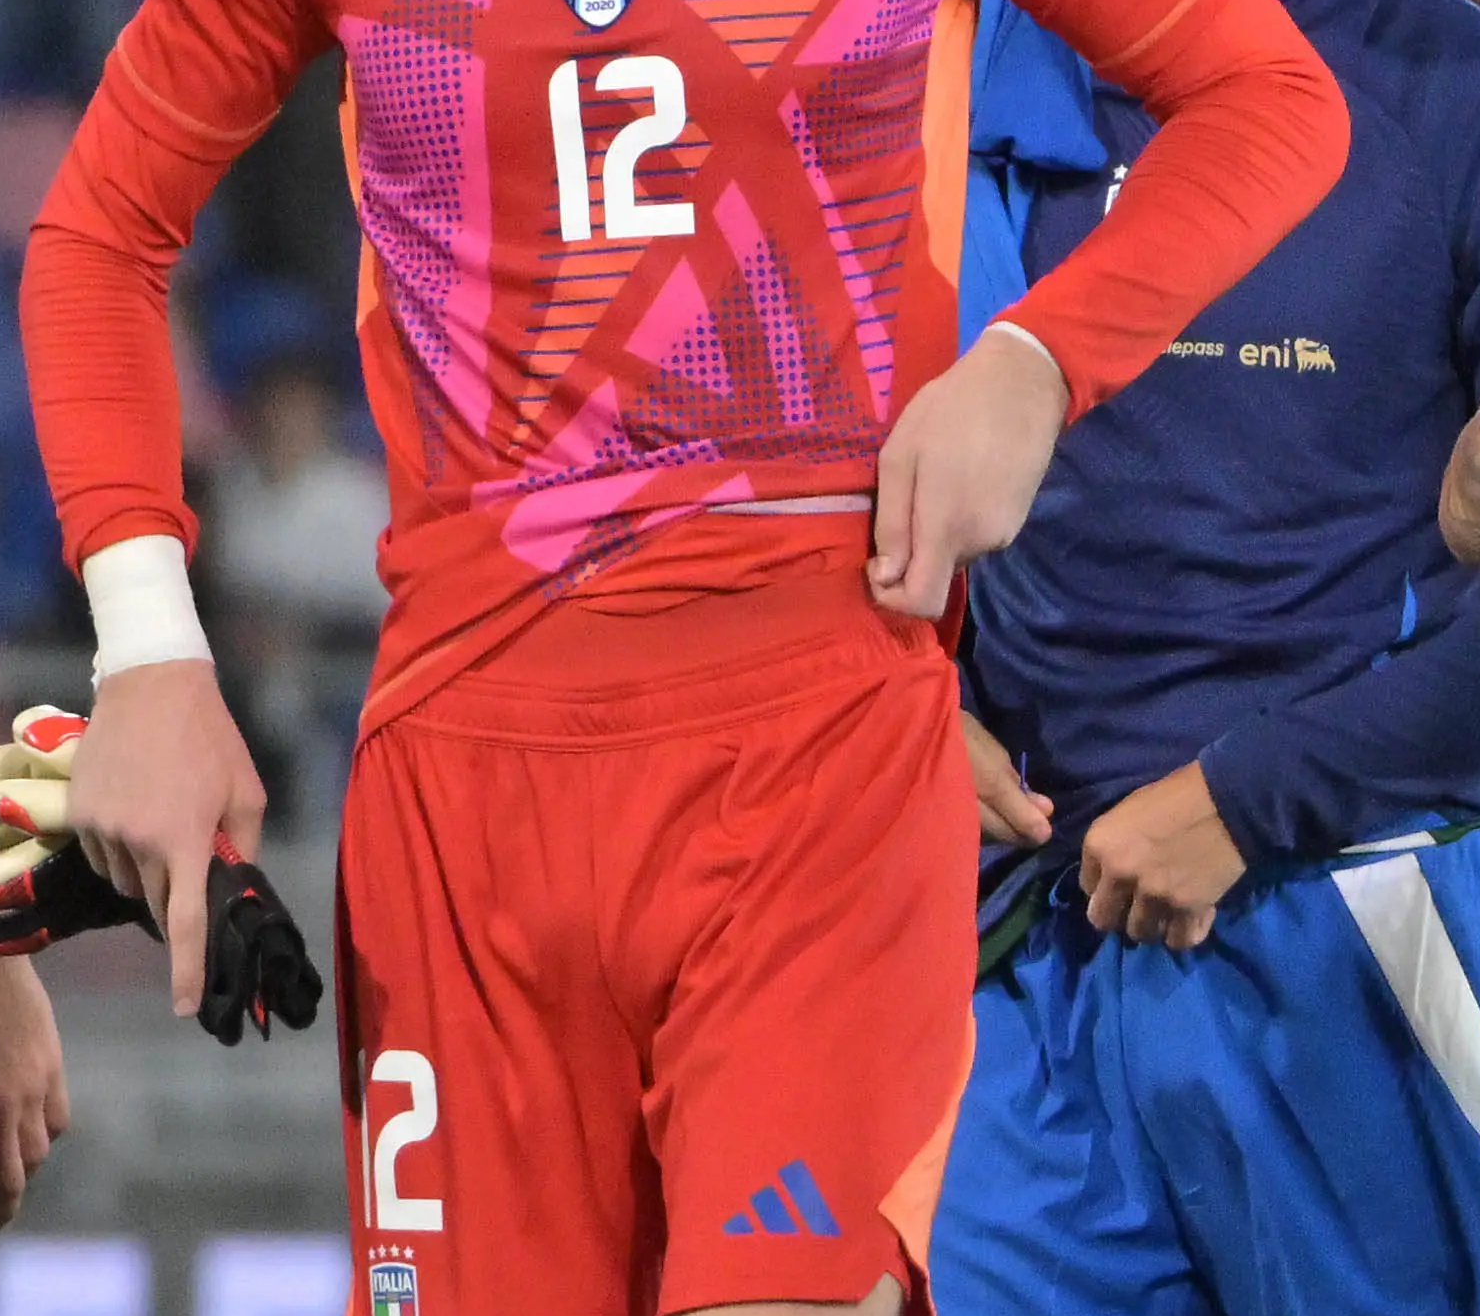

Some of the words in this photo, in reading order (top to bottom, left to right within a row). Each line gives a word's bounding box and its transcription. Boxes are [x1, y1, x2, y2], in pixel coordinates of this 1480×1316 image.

[584, 0, 616, 12] 2020
[547, 55, 696, 242] 12
[1161, 340, 1225, 359] lepass
[1239, 337, 1291, 368] eni
[372, 1271, 414, 1293] ITALIA
